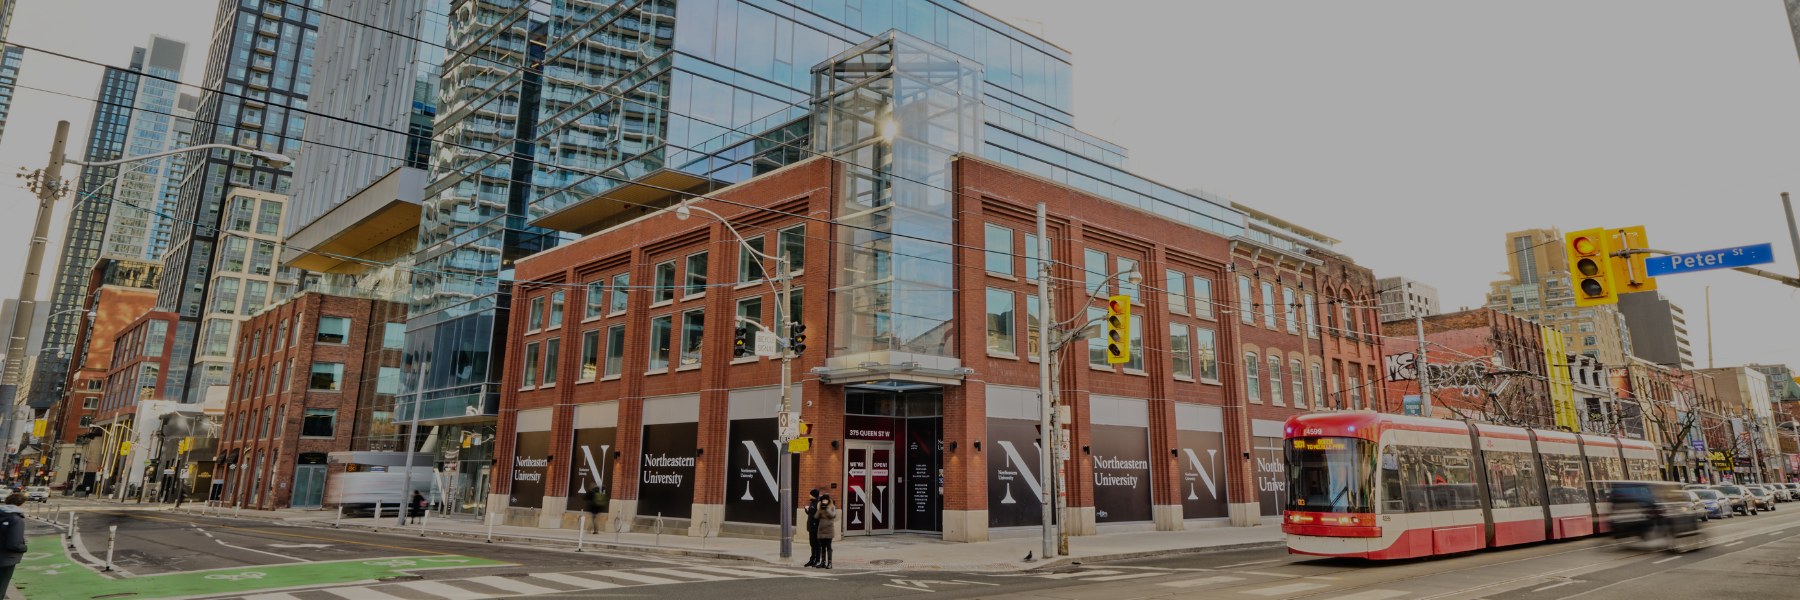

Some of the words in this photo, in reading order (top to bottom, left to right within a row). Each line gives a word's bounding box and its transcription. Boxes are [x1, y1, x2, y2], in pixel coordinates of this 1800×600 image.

[1671, 252, 1724, 270] Peter
[1733, 247, 1743, 256] St
[757, 335, 775, 343] BICYCLE
[757, 344, 774, 353] SIGNAL
[1293, 440, 1306, 449] 501
[515, 455, 548, 467] Northeastern
[644, 453, 695, 467] Northeastern
[1093, 455, 1148, 470] Northeastern
[514, 469, 541, 484] University
[643, 470, 683, 488] University
[1094, 472, 1138, 489] University
